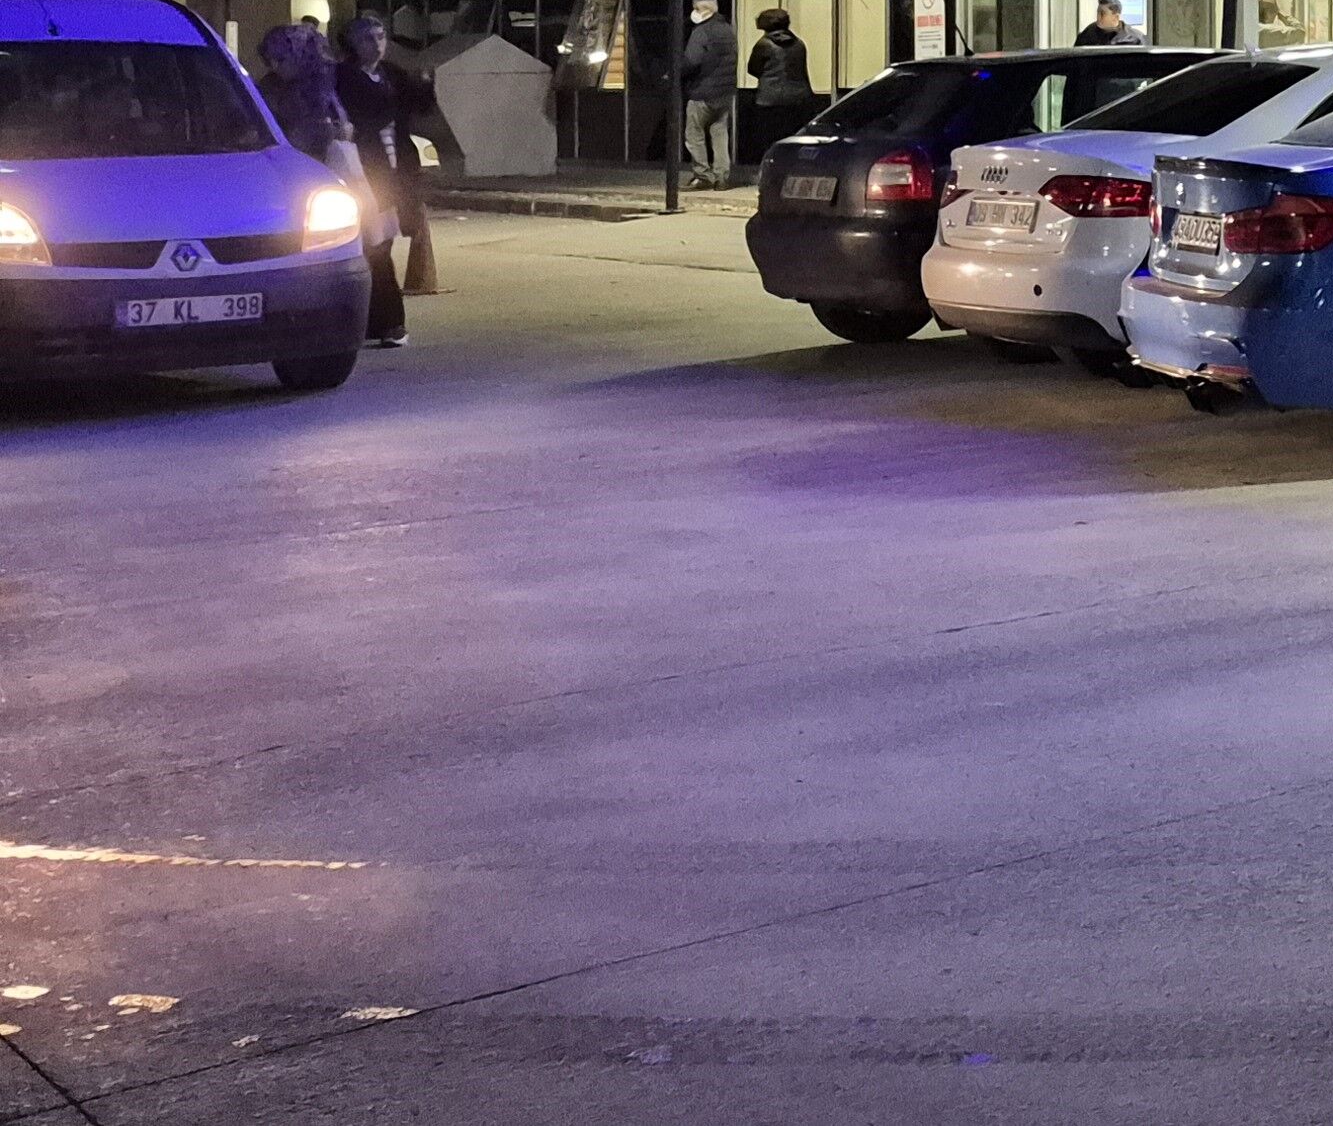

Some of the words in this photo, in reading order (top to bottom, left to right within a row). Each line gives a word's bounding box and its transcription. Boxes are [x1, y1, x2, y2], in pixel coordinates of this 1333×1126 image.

[130, 302, 158, 324] 37
[173, 300, 199, 322] KL
[222, 295, 260, 318] 398
